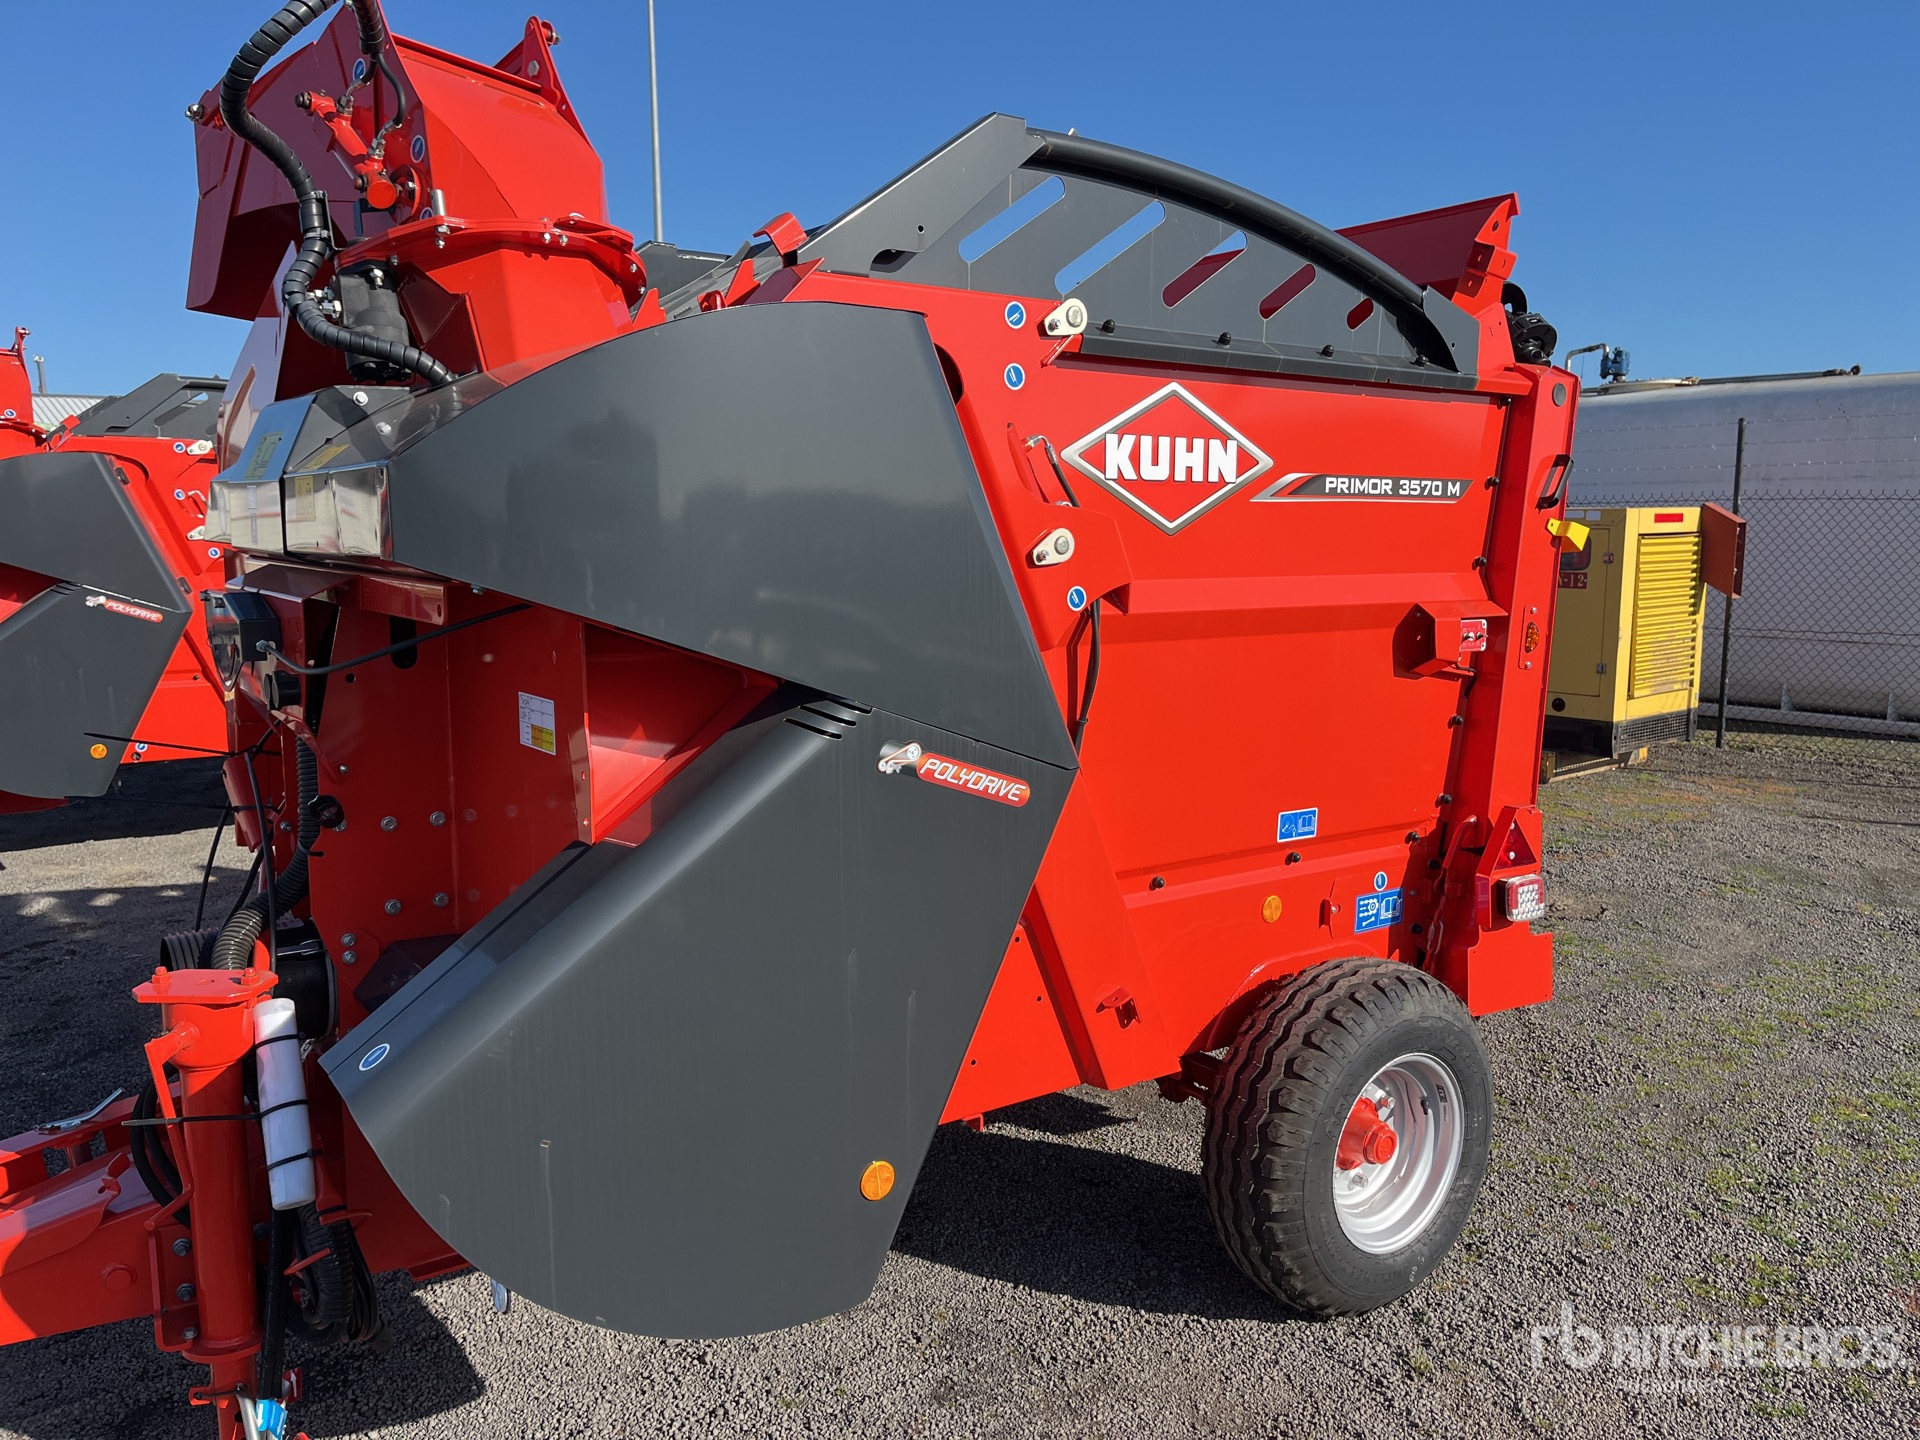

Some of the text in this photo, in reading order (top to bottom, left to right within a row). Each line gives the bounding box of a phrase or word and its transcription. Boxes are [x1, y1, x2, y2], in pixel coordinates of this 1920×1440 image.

[1105, 433, 1237, 484] KUHN
[1325, 477, 1460, 498] PRIMOR 3570 M
[107, 601, 158, 621] POLYDRIVE
[920, 758, 1026, 802] POLYDRIVE
